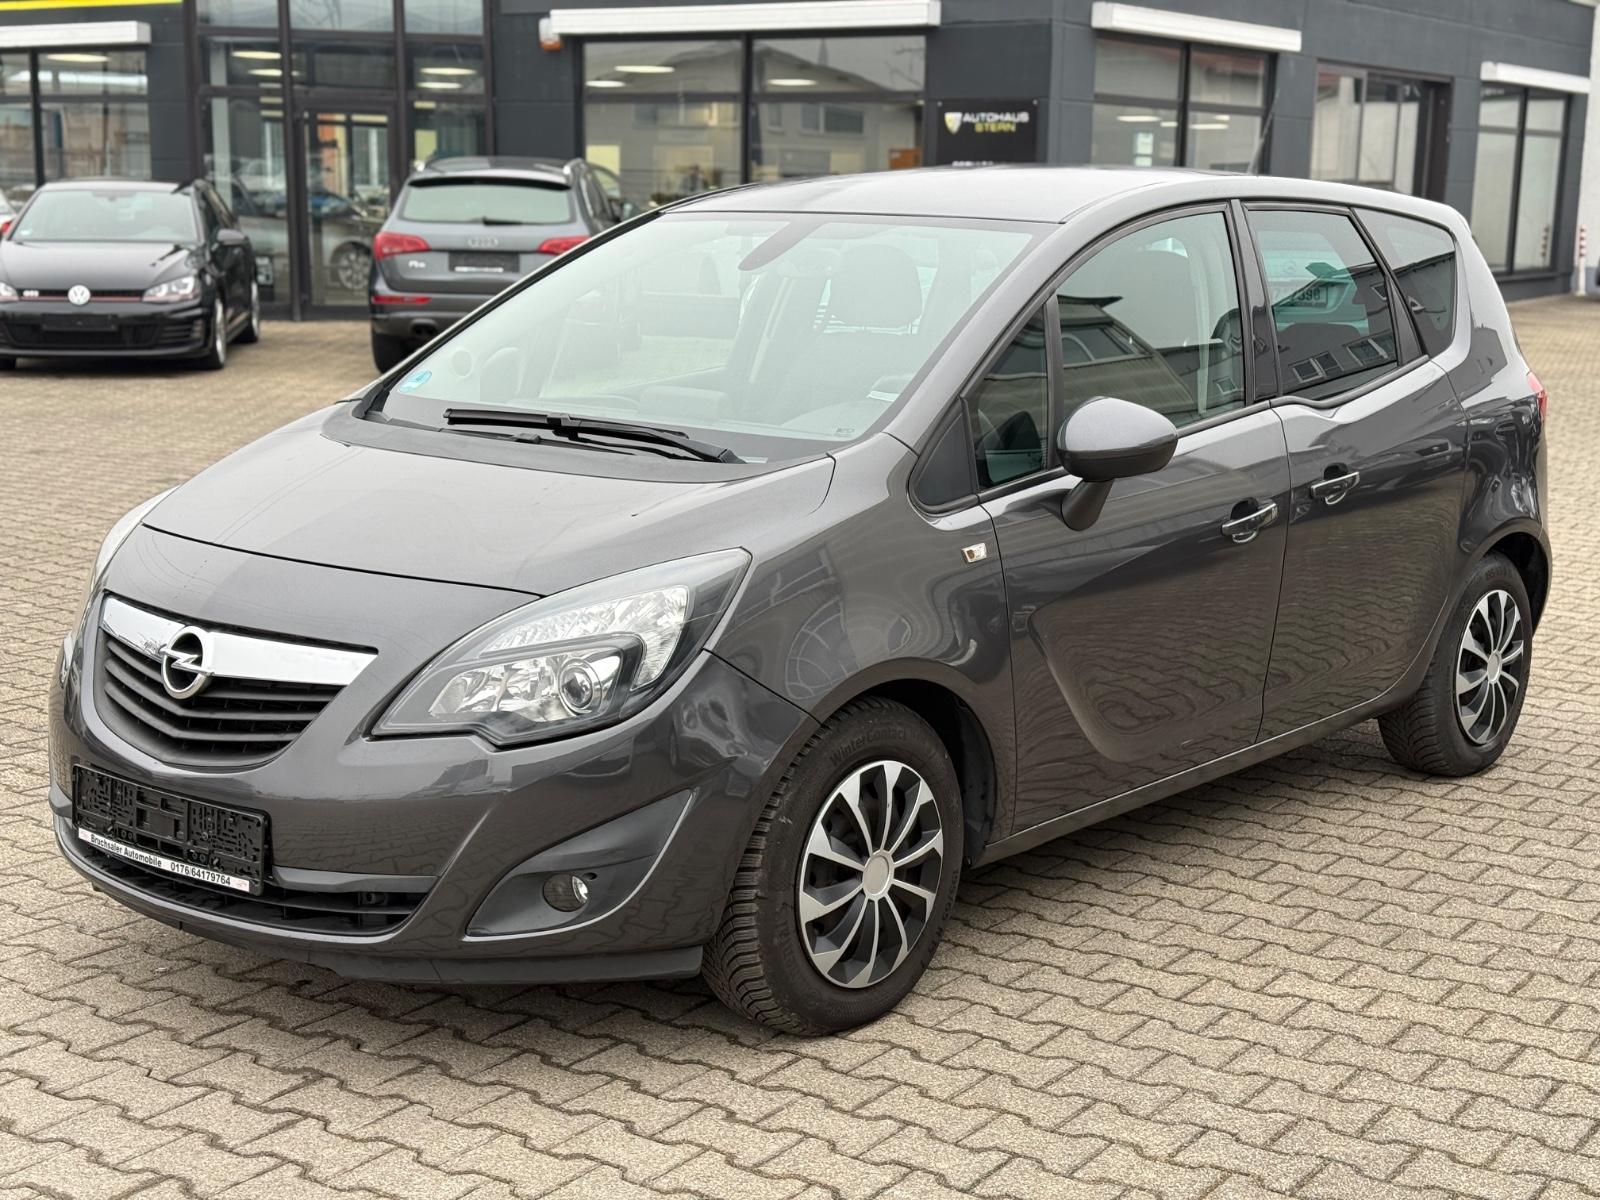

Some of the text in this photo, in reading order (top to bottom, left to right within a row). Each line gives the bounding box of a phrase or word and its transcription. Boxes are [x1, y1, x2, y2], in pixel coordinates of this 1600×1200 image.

[962, 111, 1029, 123] AUTOHAUS
[90, 833, 123, 852] Bruchsaler
[123, 847, 162, 868] Automobile
